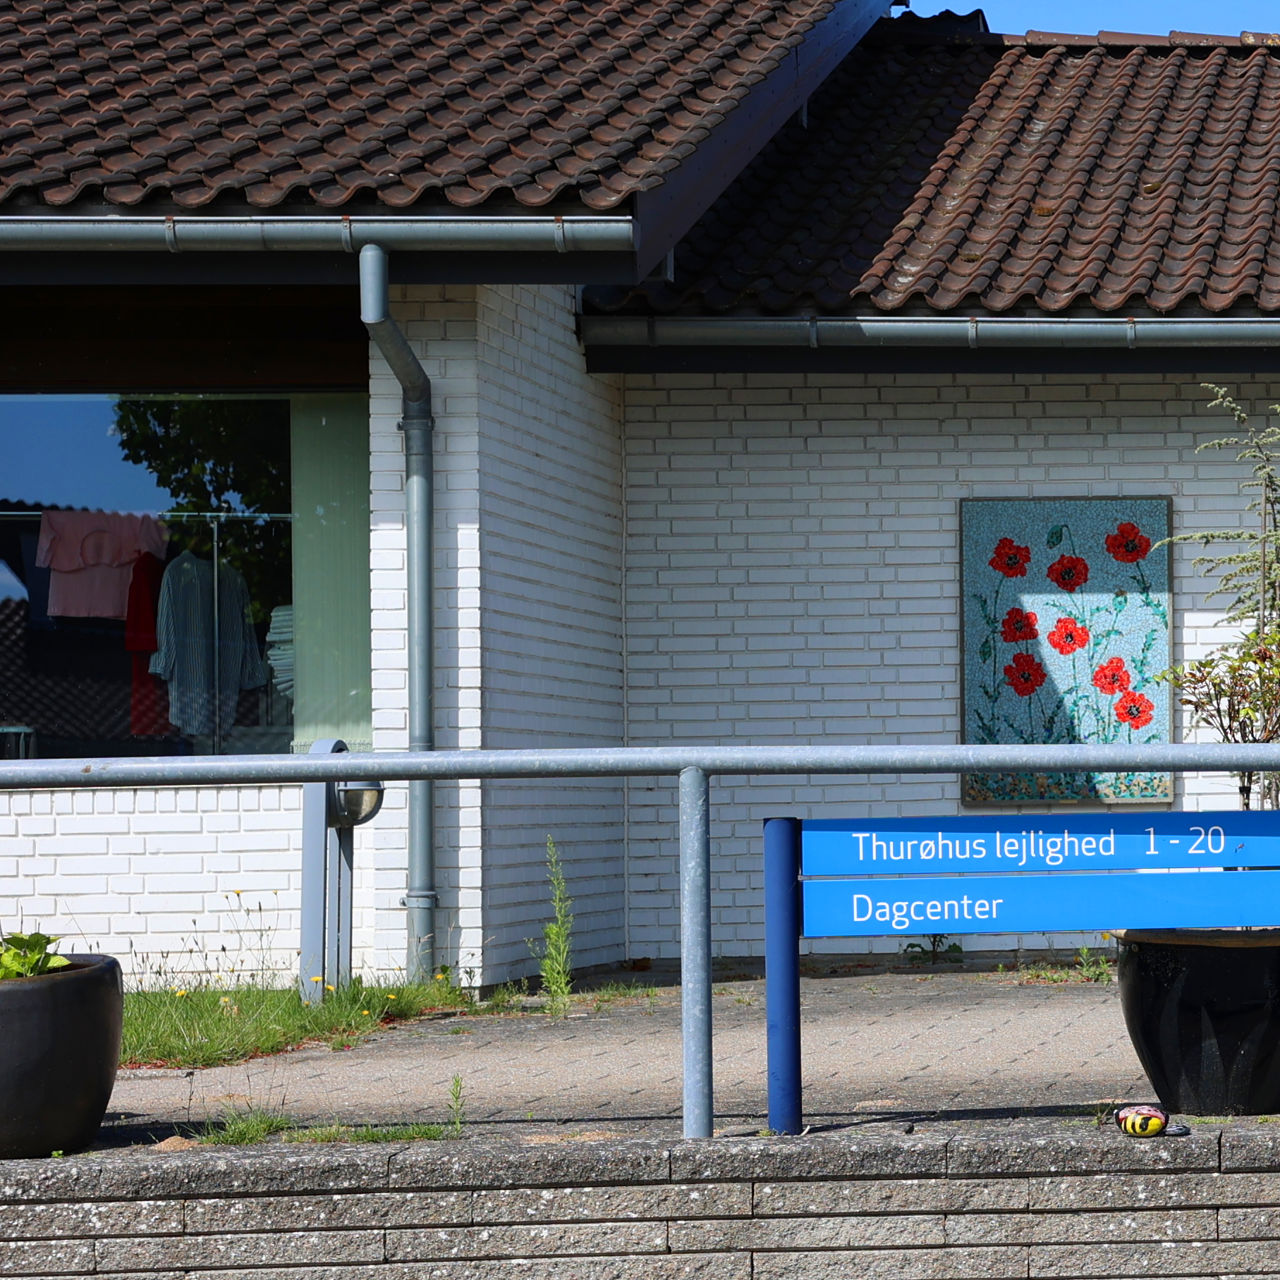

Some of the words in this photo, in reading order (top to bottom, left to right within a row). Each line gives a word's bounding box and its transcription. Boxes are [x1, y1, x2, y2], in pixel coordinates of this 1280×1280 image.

[851, 831, 987, 861] Thurøhus
[995, 828, 1115, 867] lejlighed
[1144, 827, 1160, 856] 1
[1187, 825, 1226, 855] 20
[851, 893, 1005, 930] Dagcenter
